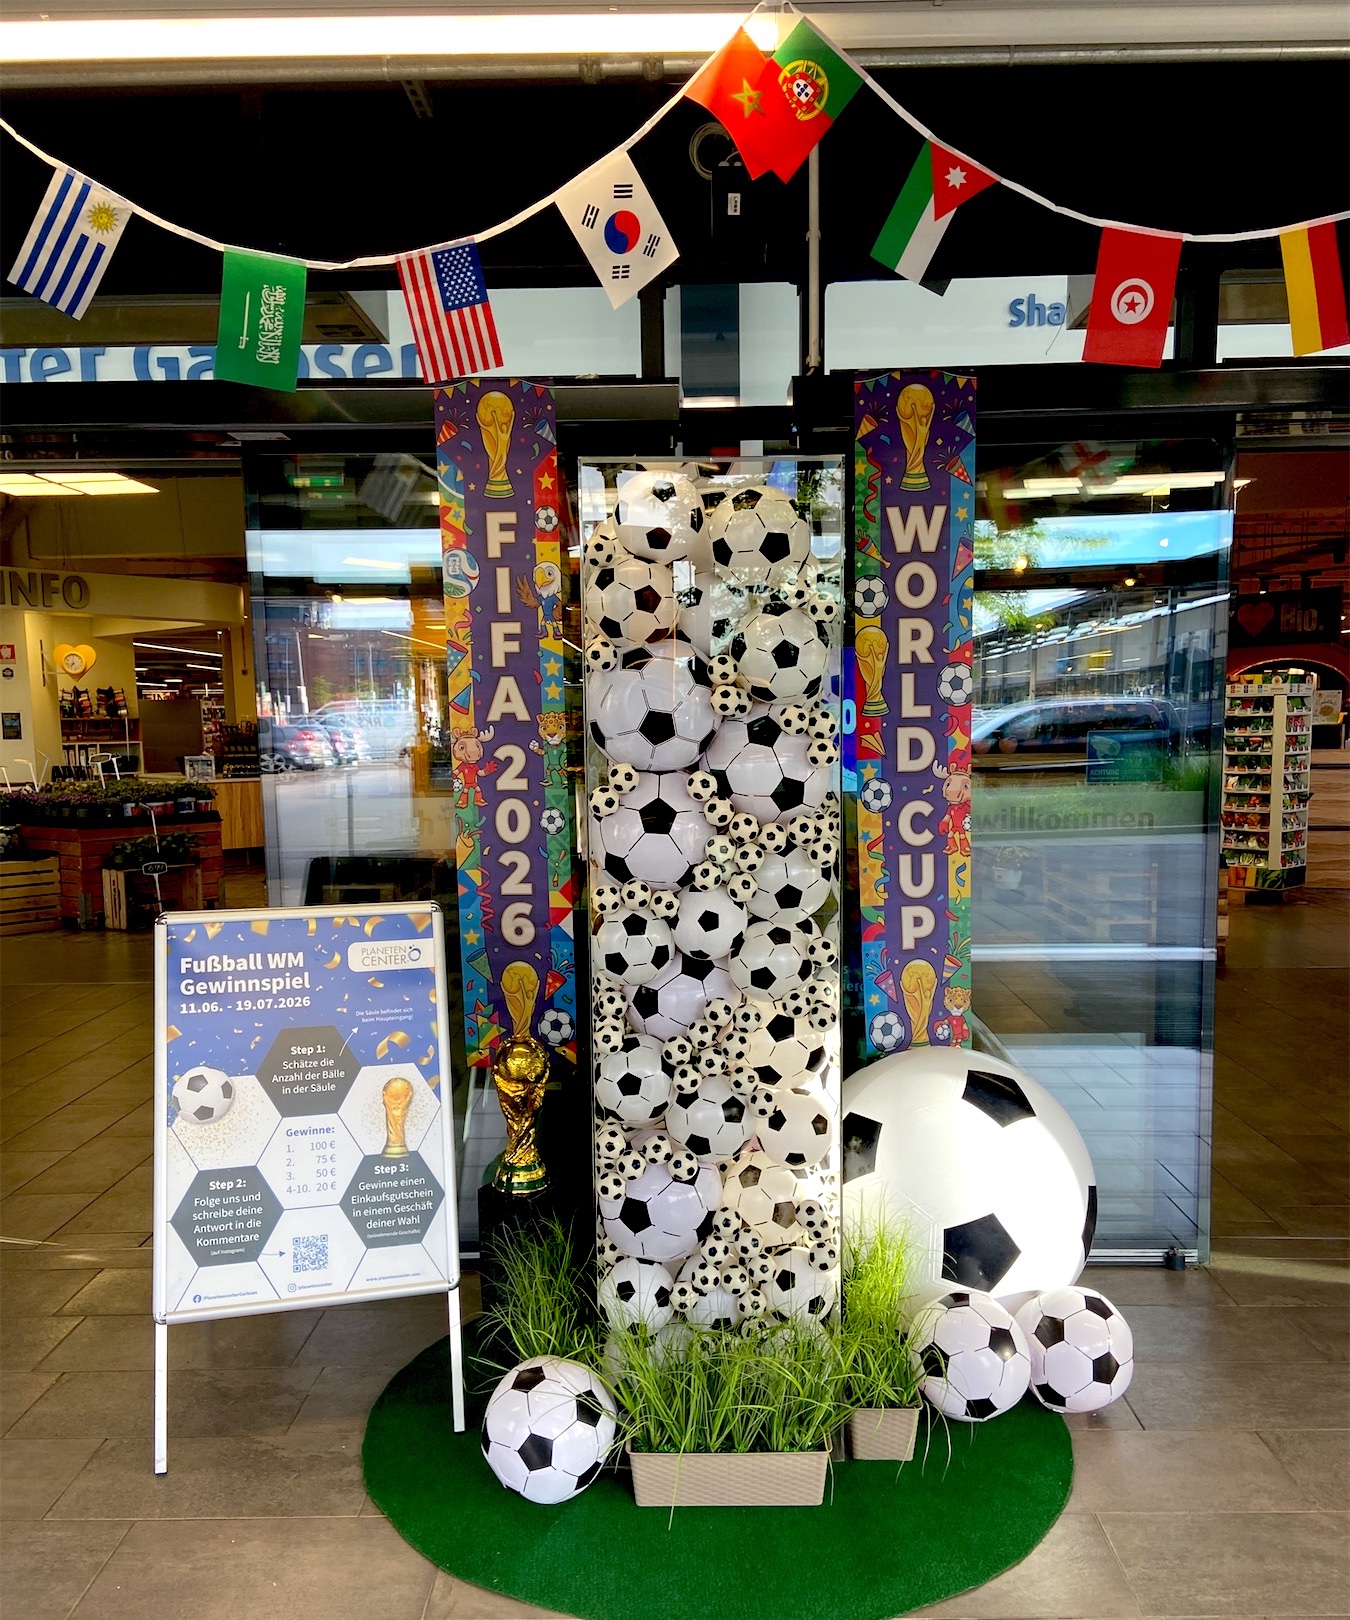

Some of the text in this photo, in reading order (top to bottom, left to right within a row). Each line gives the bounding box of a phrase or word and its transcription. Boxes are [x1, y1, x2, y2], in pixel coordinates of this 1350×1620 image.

[485, 511, 537, 948] FIFA 2026
[885, 505, 947, 950] WORLD CUP
[973, 806, 1154, 831] willkommen
[361, 946, 407, 956] PLANETEN
[180, 952, 304, 974] Fußball WM
[362, 955, 407, 967] CENTER
[180, 972, 311, 995] Gewinnspiel
[180, 1002, 223, 1014] 11.06.
[236, 996, 311, 1011] 19.07.2026
[290, 1044, 326, 1056] Step 1:
[282, 1058, 334, 1070] Schätze die
[272, 1069, 345, 1082] Anzahl der Bälle
[282, 1082, 336, 1094] in der Säule
[286, 1126, 334, 1137] Gewinne:
[286, 1140, 336, 1153] 1. 100 €
[286, 1154, 336, 1166] 2. 75 €
[286, 1168, 336, 1180] 3. 50 €
[374, 1163, 409, 1174] Step 3:
[209, 1178, 246, 1190] Step 2:
[286, 1182, 336, 1194] 4-10. 20 €
[358, 1177, 425, 1190] Gewinne einen
[194, 1192, 260, 1208] Folge uns und
[351, 1188, 434, 1204] Einkaufsgutschein
[192, 1206, 262, 1220] schreibe deine
[352, 1200, 434, 1217] in einem Geschäft
[194, 1218, 262, 1234] Antwort in die
[366, 1215, 420, 1229] deiner Wahl
[196, 1233, 260, 1247] Kommentare
